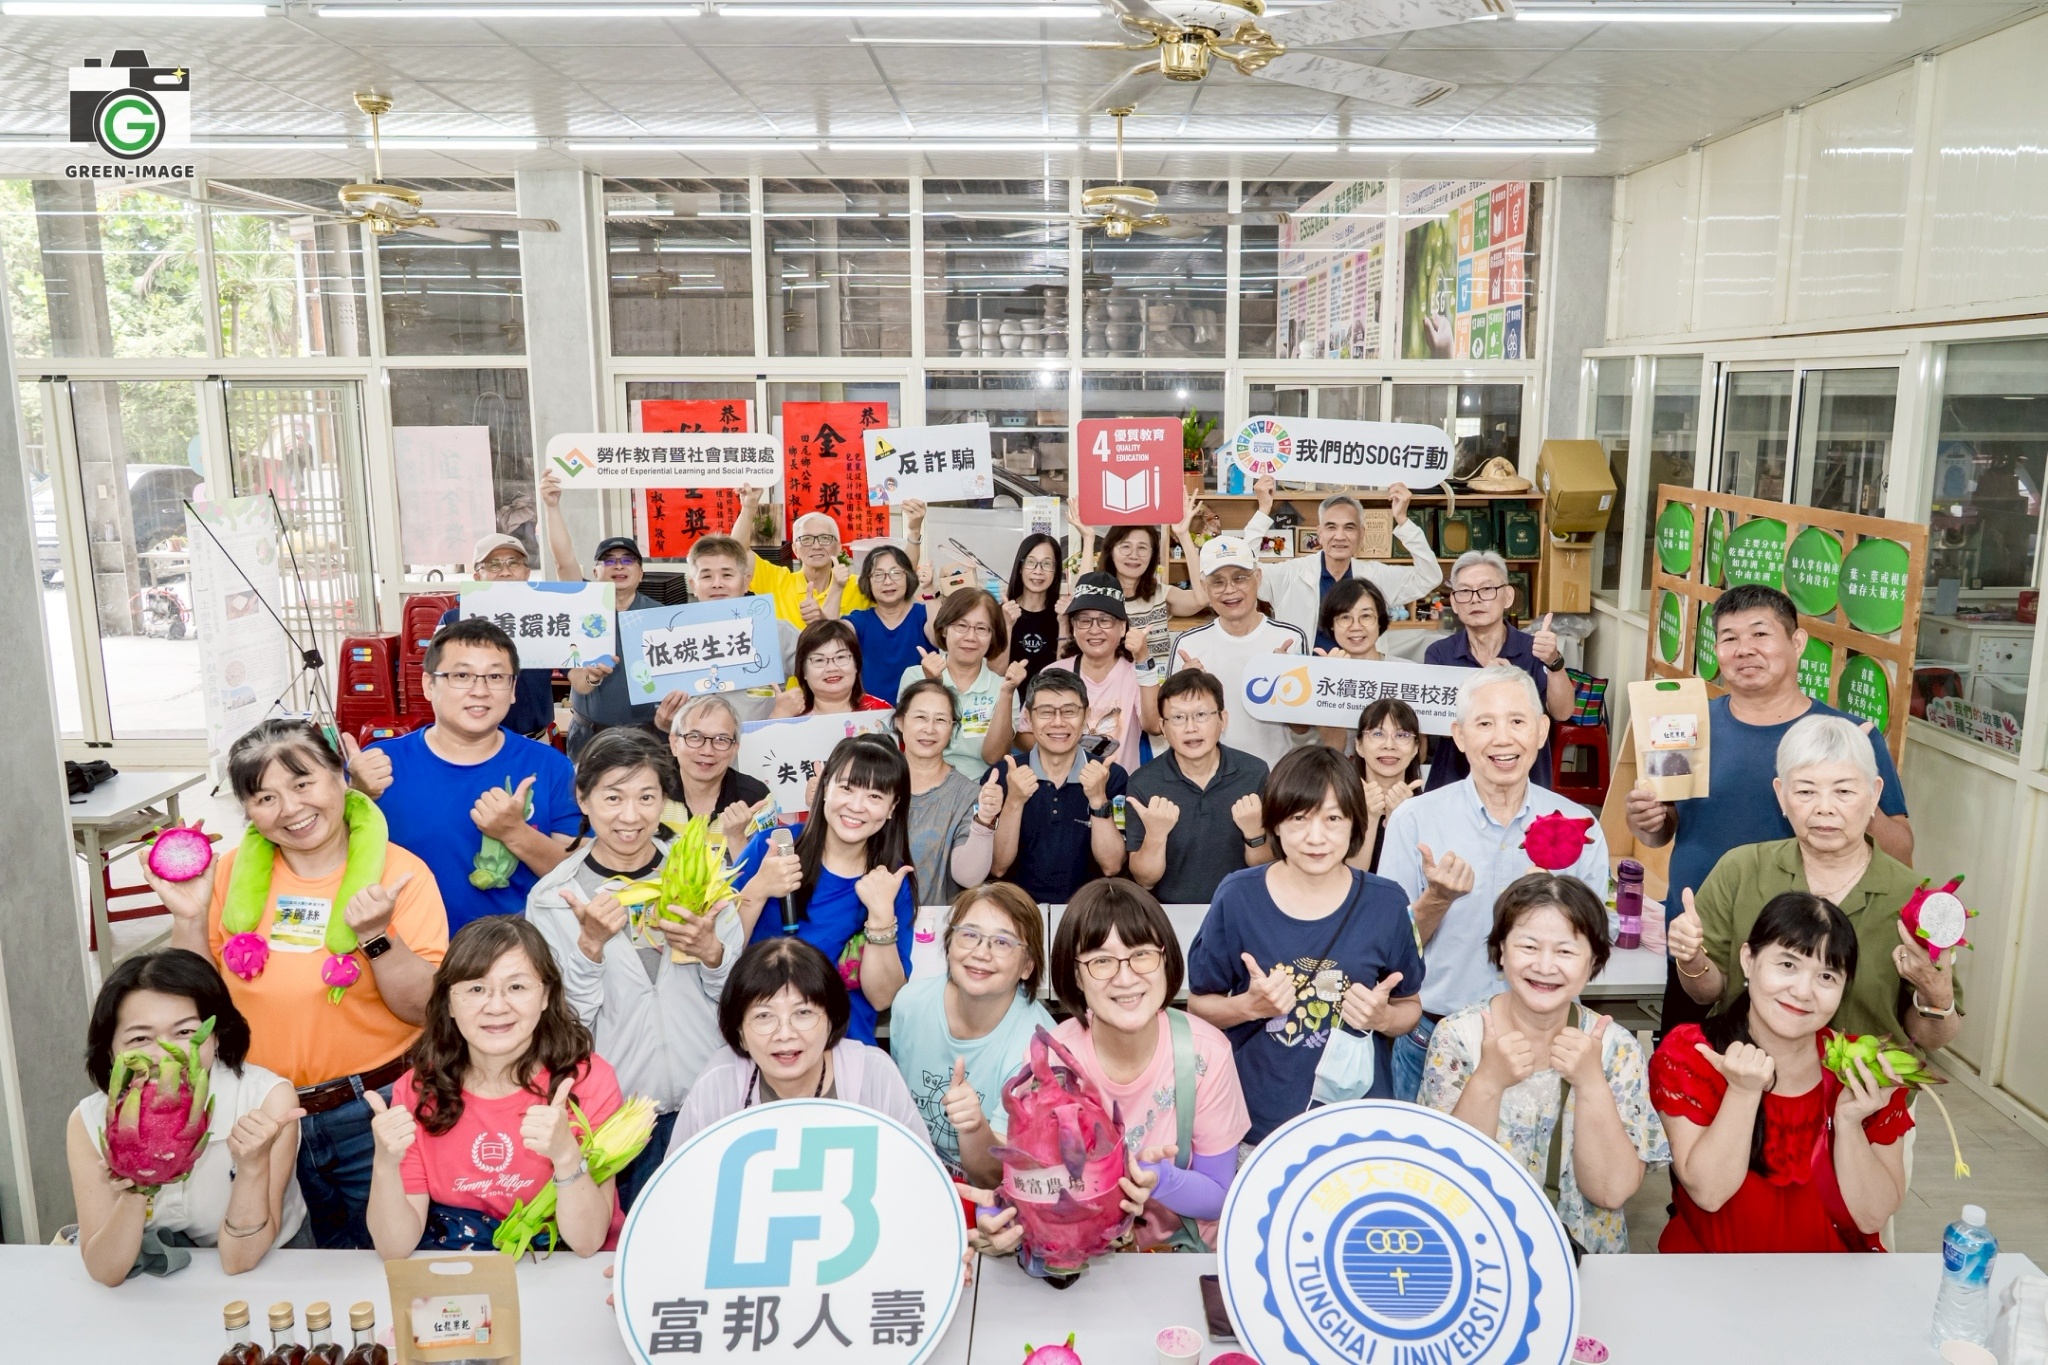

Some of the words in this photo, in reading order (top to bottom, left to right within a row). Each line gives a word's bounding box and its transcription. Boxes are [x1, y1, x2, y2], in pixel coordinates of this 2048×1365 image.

[1092, 430, 1111, 462] 4
[1114, 428, 1165, 442] 優質教育
[1115, 443, 1141, 453] QUALITY
[597, 447, 775, 463] 勞作教育暨社會實踐處
[898, 447, 976, 475] 反詐騙
[1115, 453, 1149, 462] EDUCATION
[1296, 438, 1448, 471] 我們的SDG行動
[597, 467, 619, 475] Office
[620, 467, 628, 475] of
[630, 467, 673, 476] Experiential
[674, 467, 706, 476] Learning
[707, 467, 721, 475] and
[722, 467, 744, 475] Social
[745, 467, 774, 475] Practice
[811, 423, 847, 516] 金獎
[469, 612, 571, 638] 善環境
[645, 634, 752, 668] 低碳生活
[1316, 676, 1459, 706] 永續發展暨校務
[1316, 699, 1337, 709] Office
[1953, 701, 2002, 729] 我們的故事
[452, 1177, 493, 1193] Tommy
[495, 1173, 535, 1192] Hilfiger
[649, 1289, 926, 1356] 富邦人壽
[1295, 1256, 1378, 1364] TUNGHAI
[1394, 1259, 1503, 1365] UNIVERSITY
